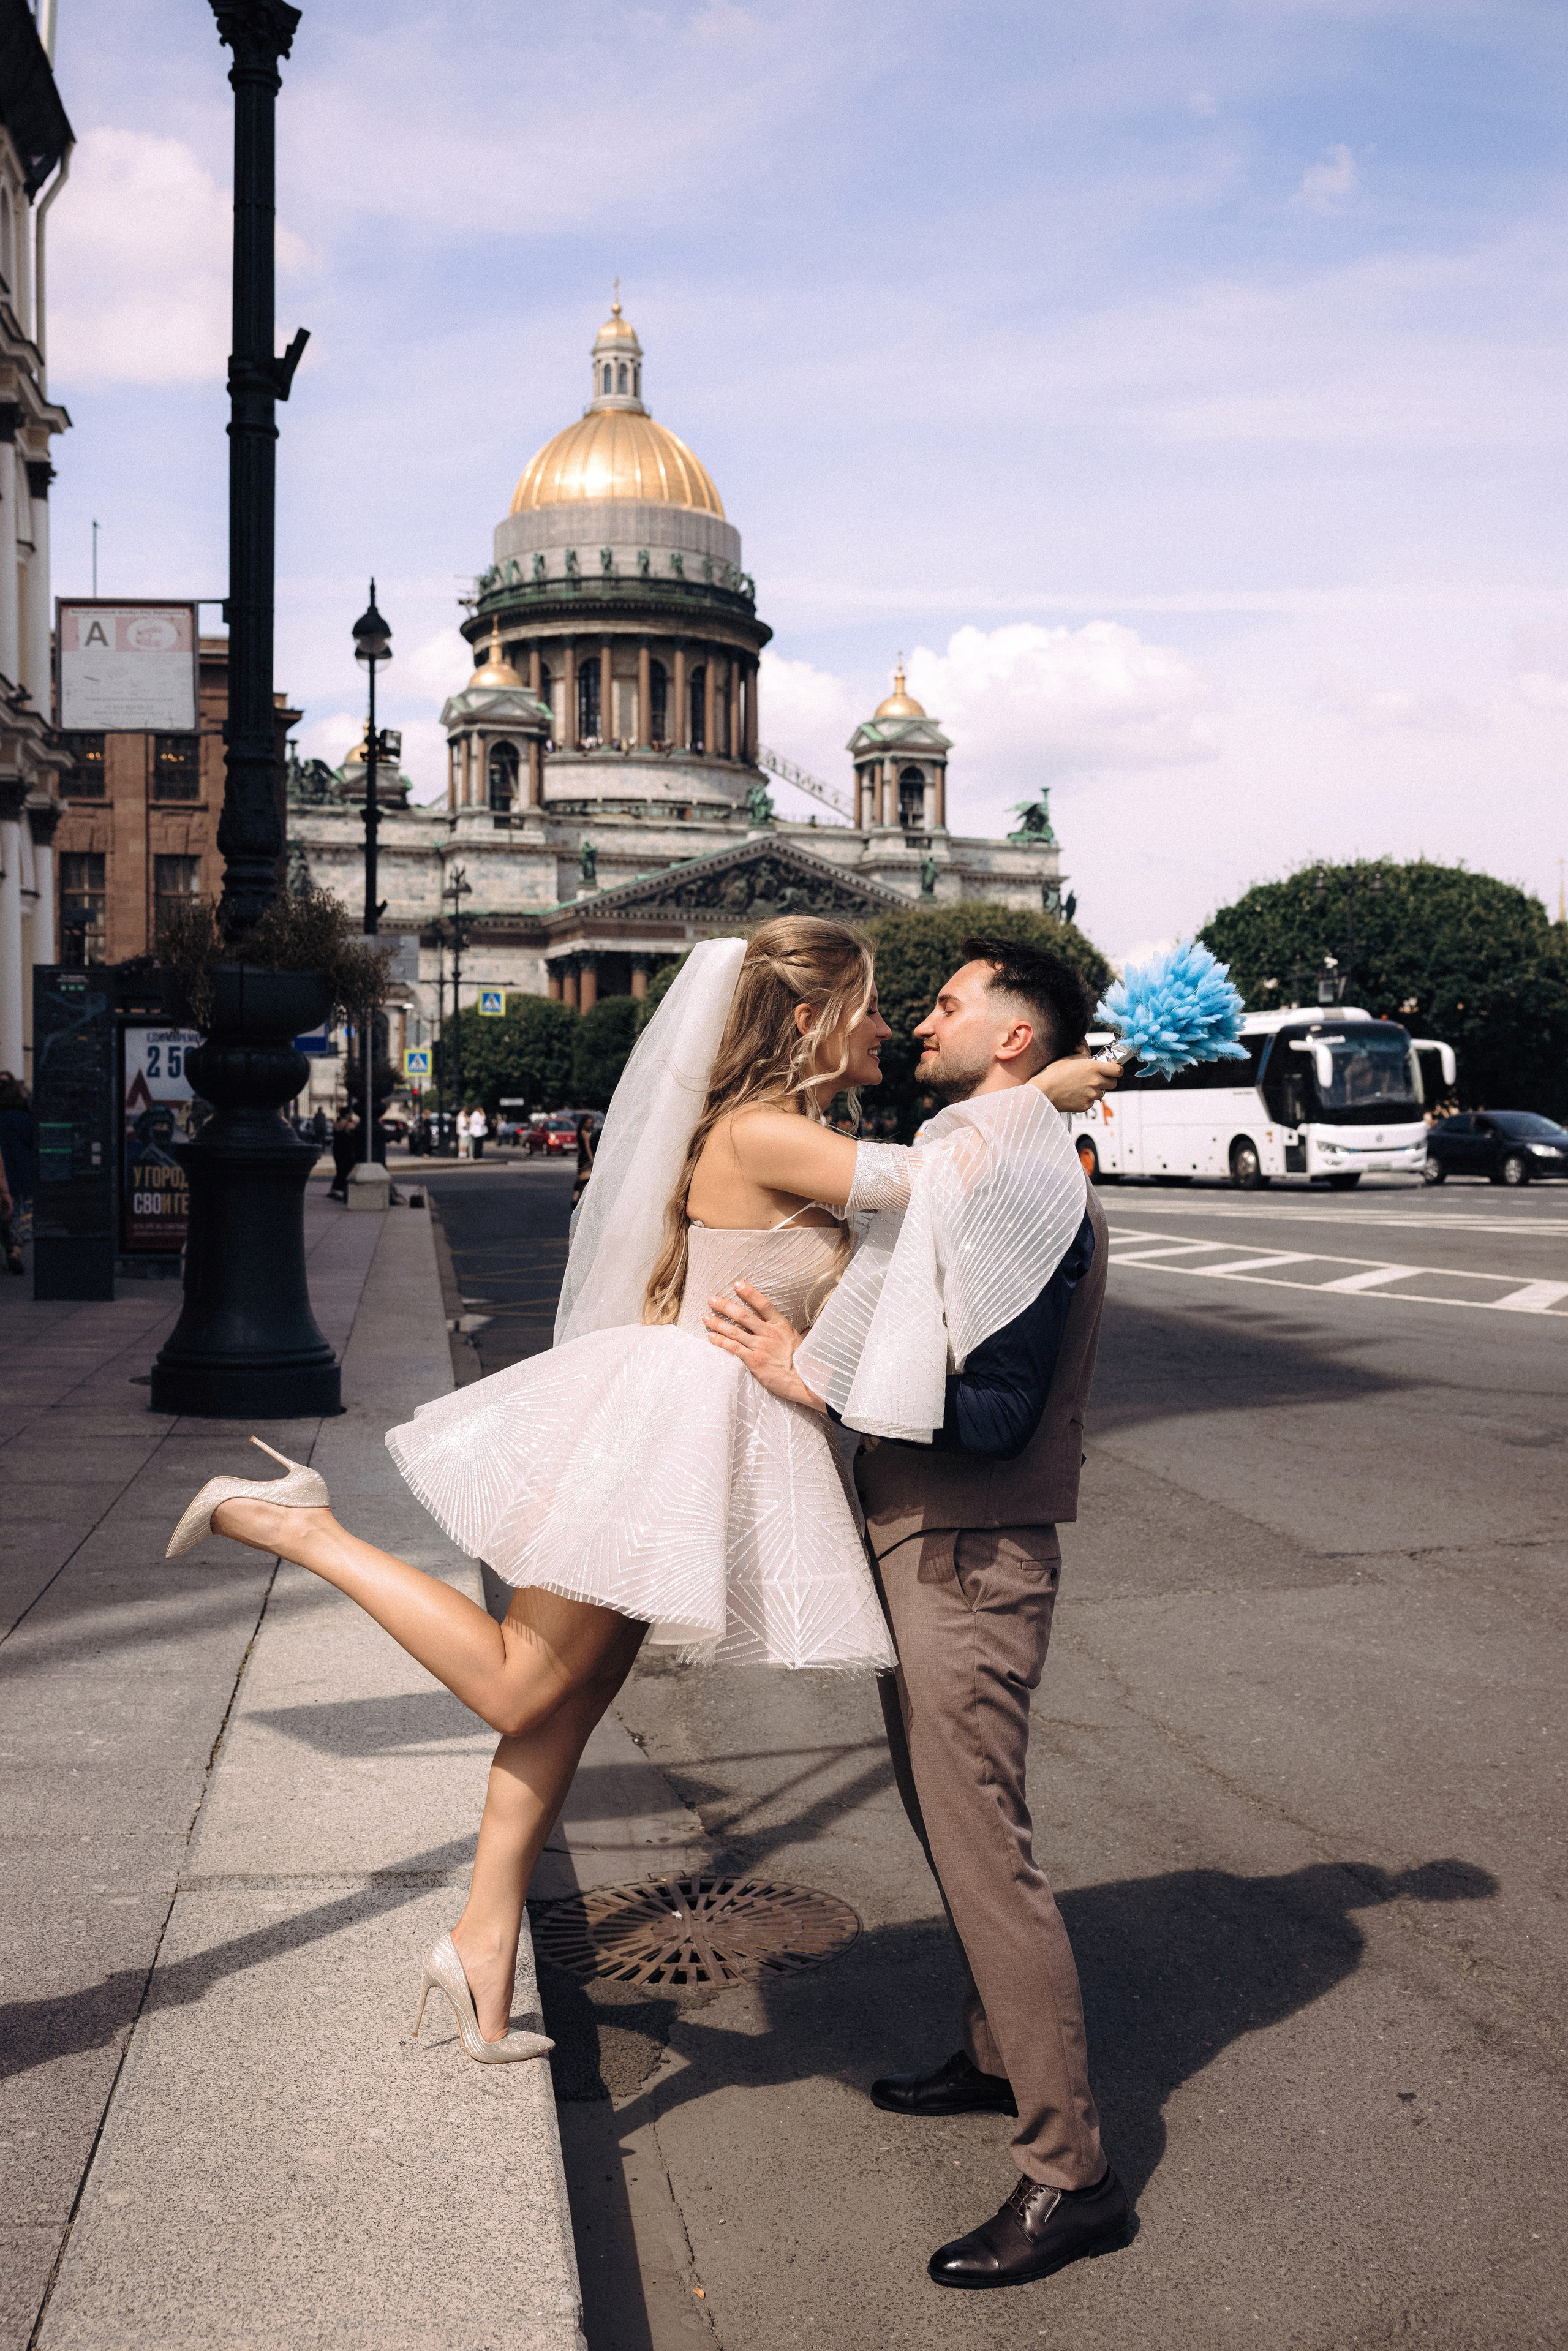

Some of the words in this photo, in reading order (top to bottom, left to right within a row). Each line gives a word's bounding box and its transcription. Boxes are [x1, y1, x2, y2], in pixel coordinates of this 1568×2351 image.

[85, 620, 109, 647] А
[147, 1046, 160, 1078] 2
[133, 1166, 143, 1188] У
[134, 1191, 172, 1215] СВОИ
